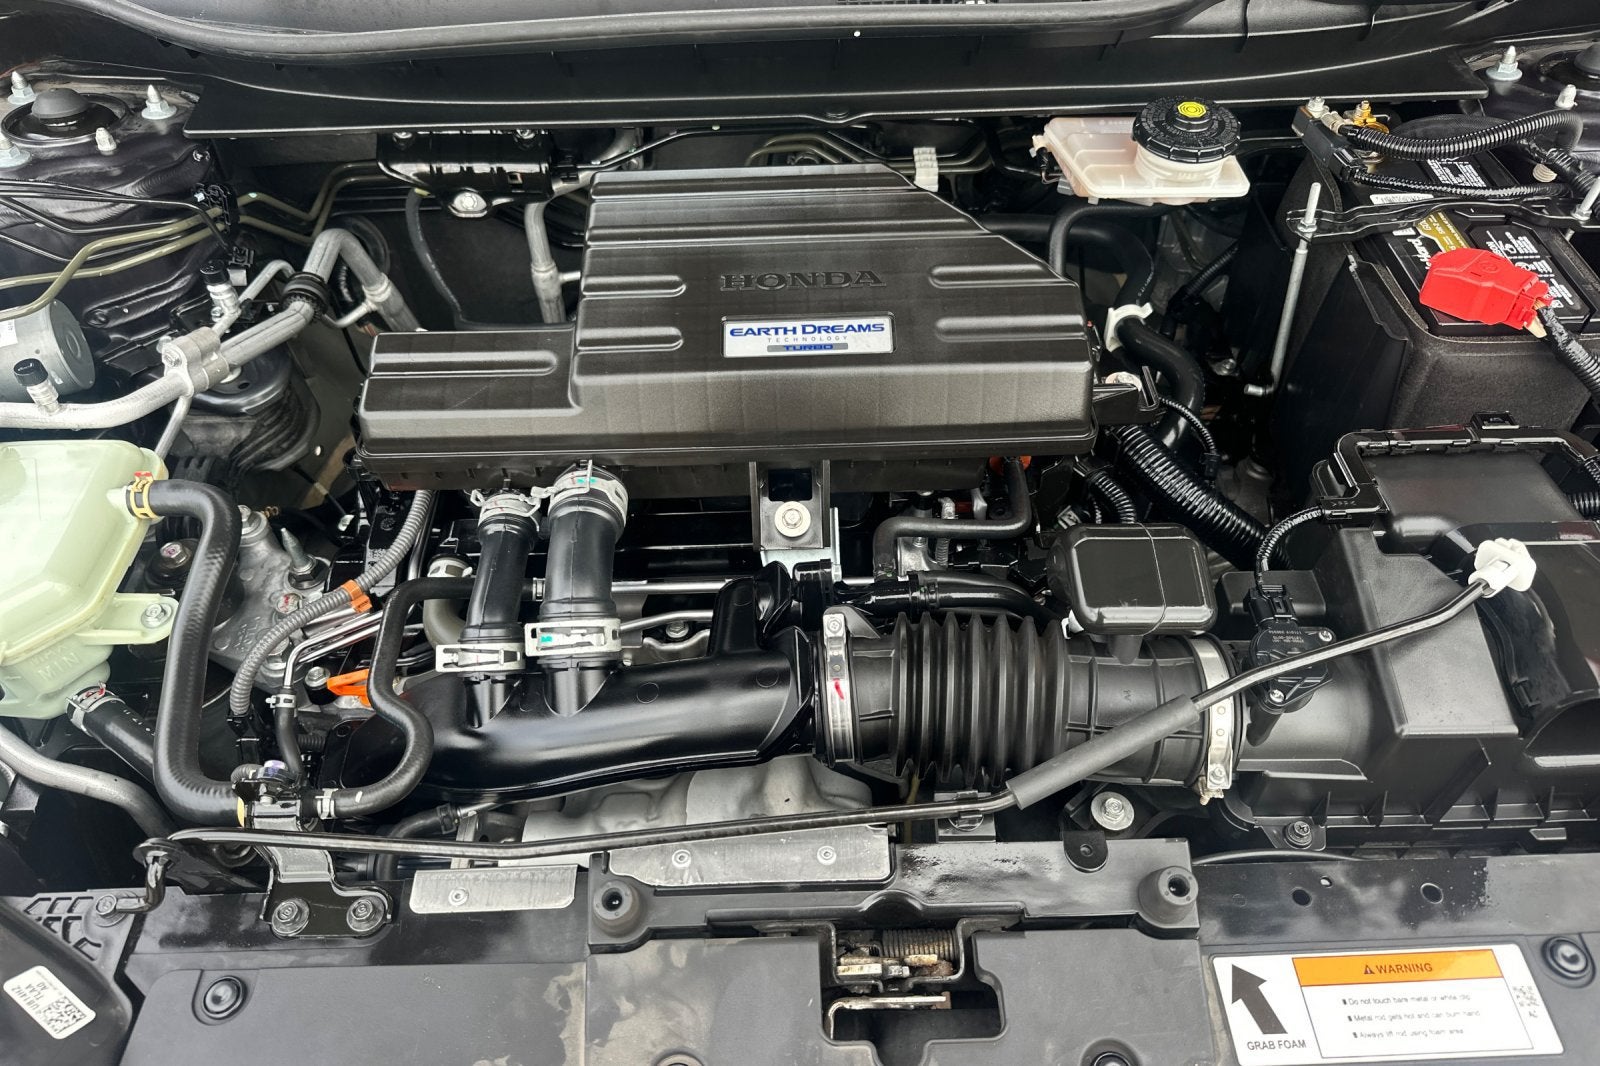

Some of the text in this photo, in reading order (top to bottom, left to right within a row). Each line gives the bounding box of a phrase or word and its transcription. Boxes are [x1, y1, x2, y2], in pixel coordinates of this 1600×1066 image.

[720, 270, 887, 292] HONDA
[730, 323, 885, 337] EARTH DREAMS
[767, 335, 848, 343] TECHNOLOGY
[1376, 963, 1433, 974] WARNING
[1353, 1014, 1373, 1022] Metal
[1247, 1039, 1307, 1051] GRAB FOAM
